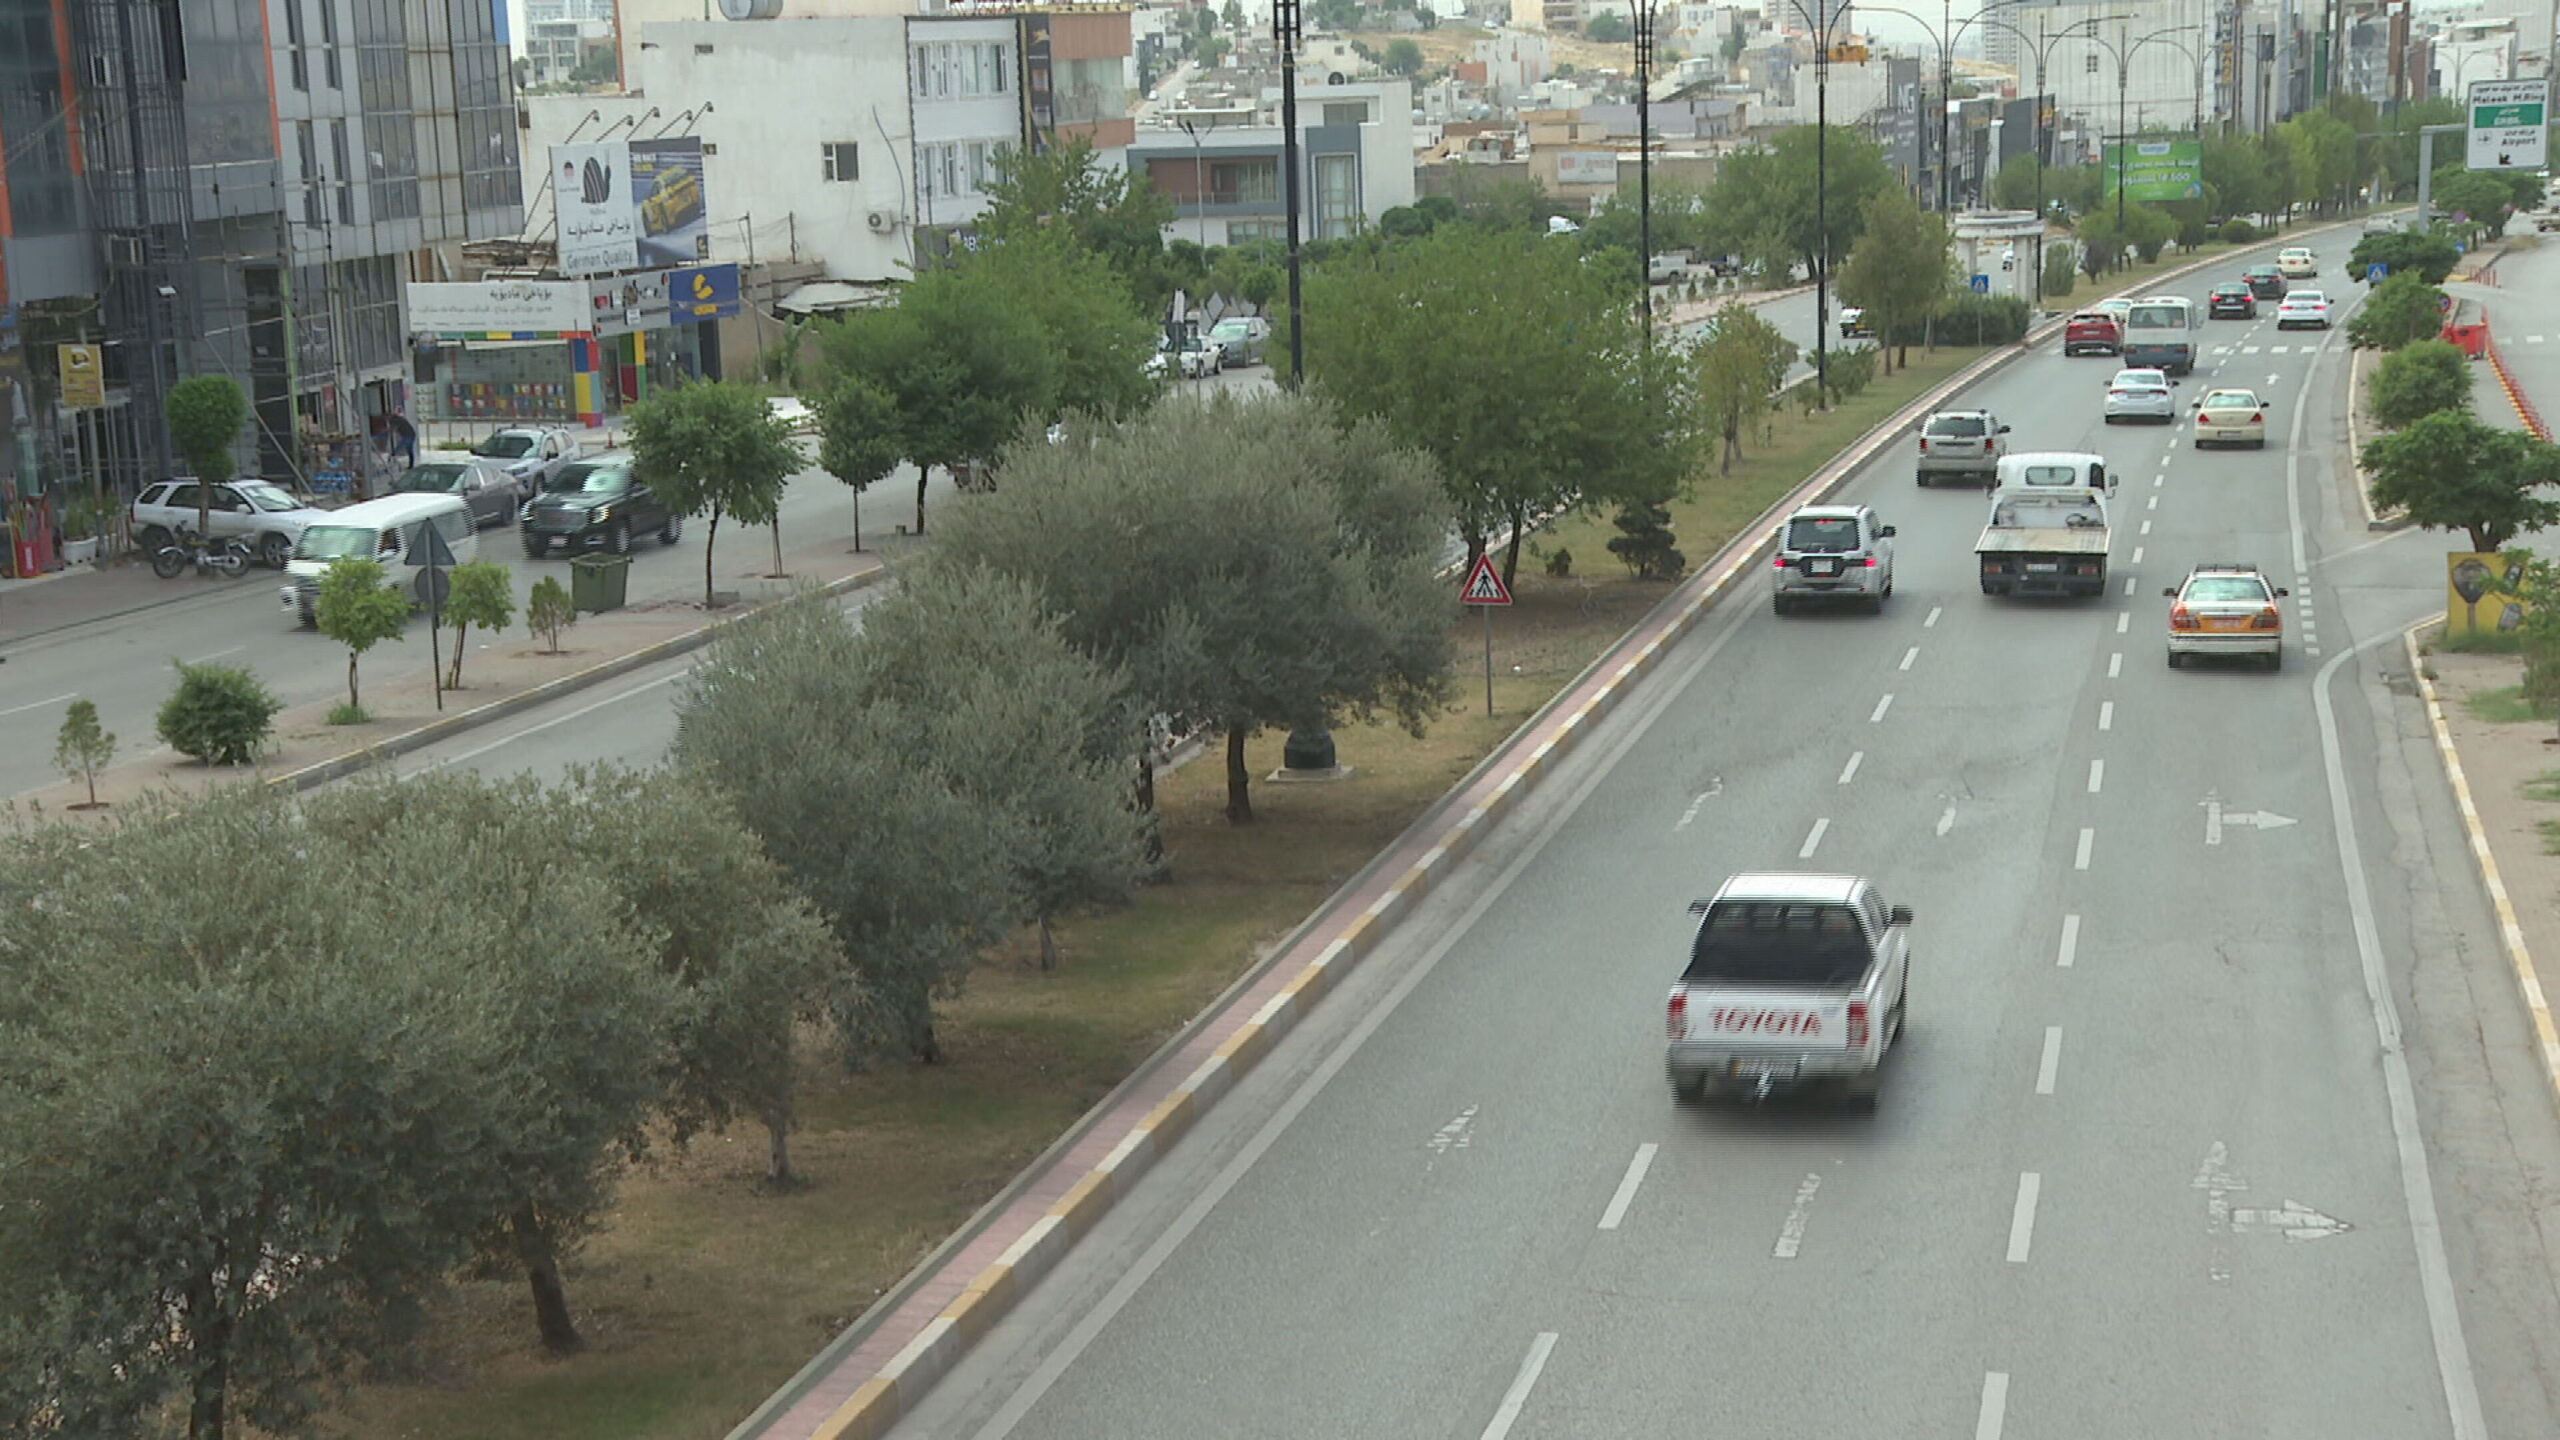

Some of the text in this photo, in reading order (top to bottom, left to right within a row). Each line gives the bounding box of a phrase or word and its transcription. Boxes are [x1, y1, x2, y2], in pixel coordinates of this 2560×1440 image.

[2501, 136, 2537, 147] Airport
[603, 248, 633, 267] Quality
[1708, 1006, 1823, 1036] TOYOTA
